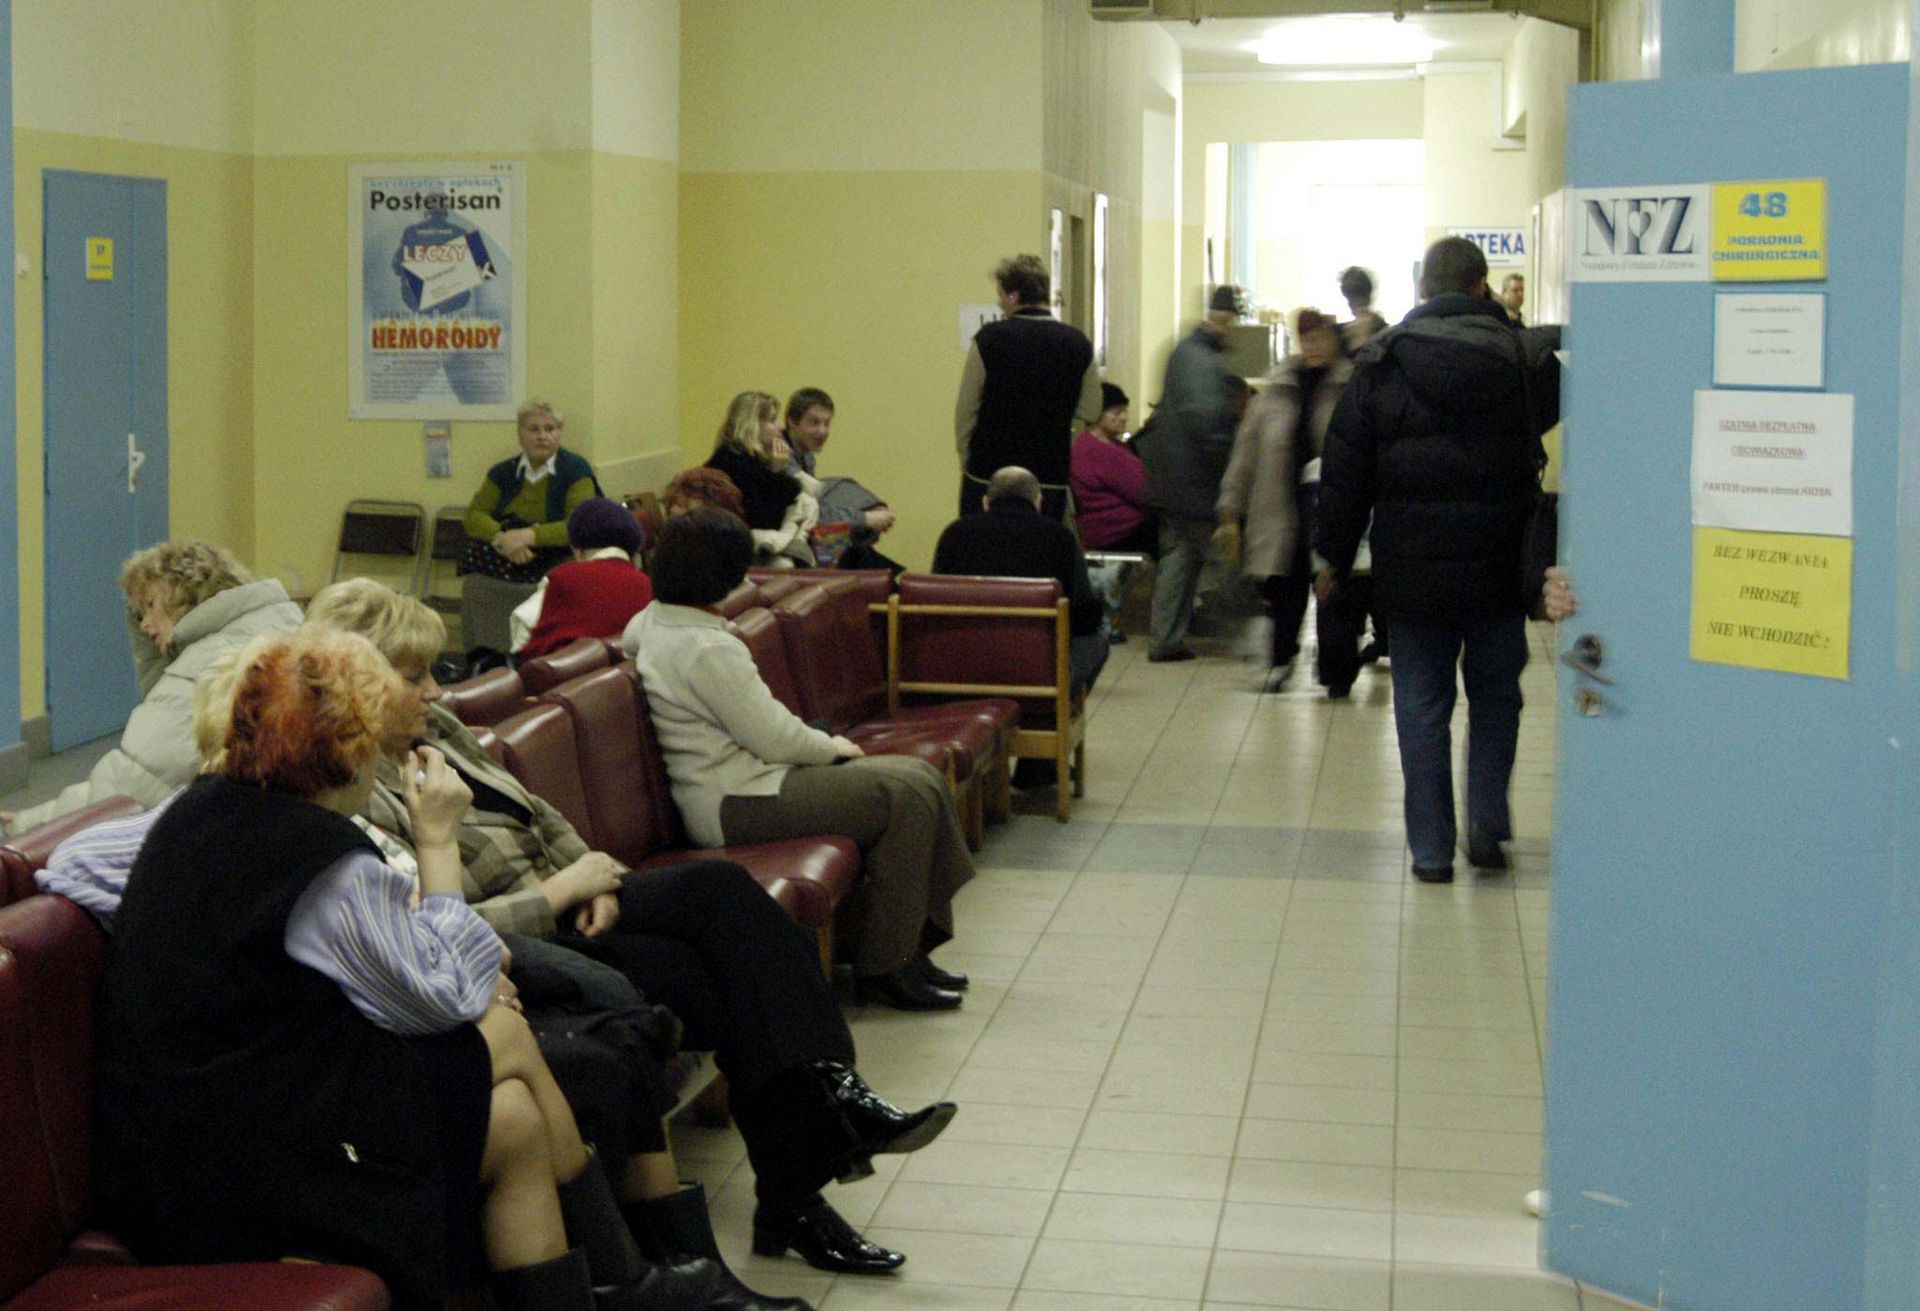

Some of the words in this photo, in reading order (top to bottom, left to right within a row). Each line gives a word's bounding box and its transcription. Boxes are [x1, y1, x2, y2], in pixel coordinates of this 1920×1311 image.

[369, 188, 501, 211] Posterisan
[1739, 191, 1788, 217] 48
[1583, 196, 1694, 256] NFZ
[1456, 233, 1525, 254] TEKA
[1727, 235, 1804, 246] PORADNIA
[402, 243, 467, 262] LECZY
[1711, 250, 1819, 262] CHIRURGICZNA
[371, 324, 501, 349] HEMOROIDY
[1713, 545, 1742, 558] BEZ
[1746, 548, 1829, 568] WEZWANIA
[1707, 620, 1734, 637] NIE
